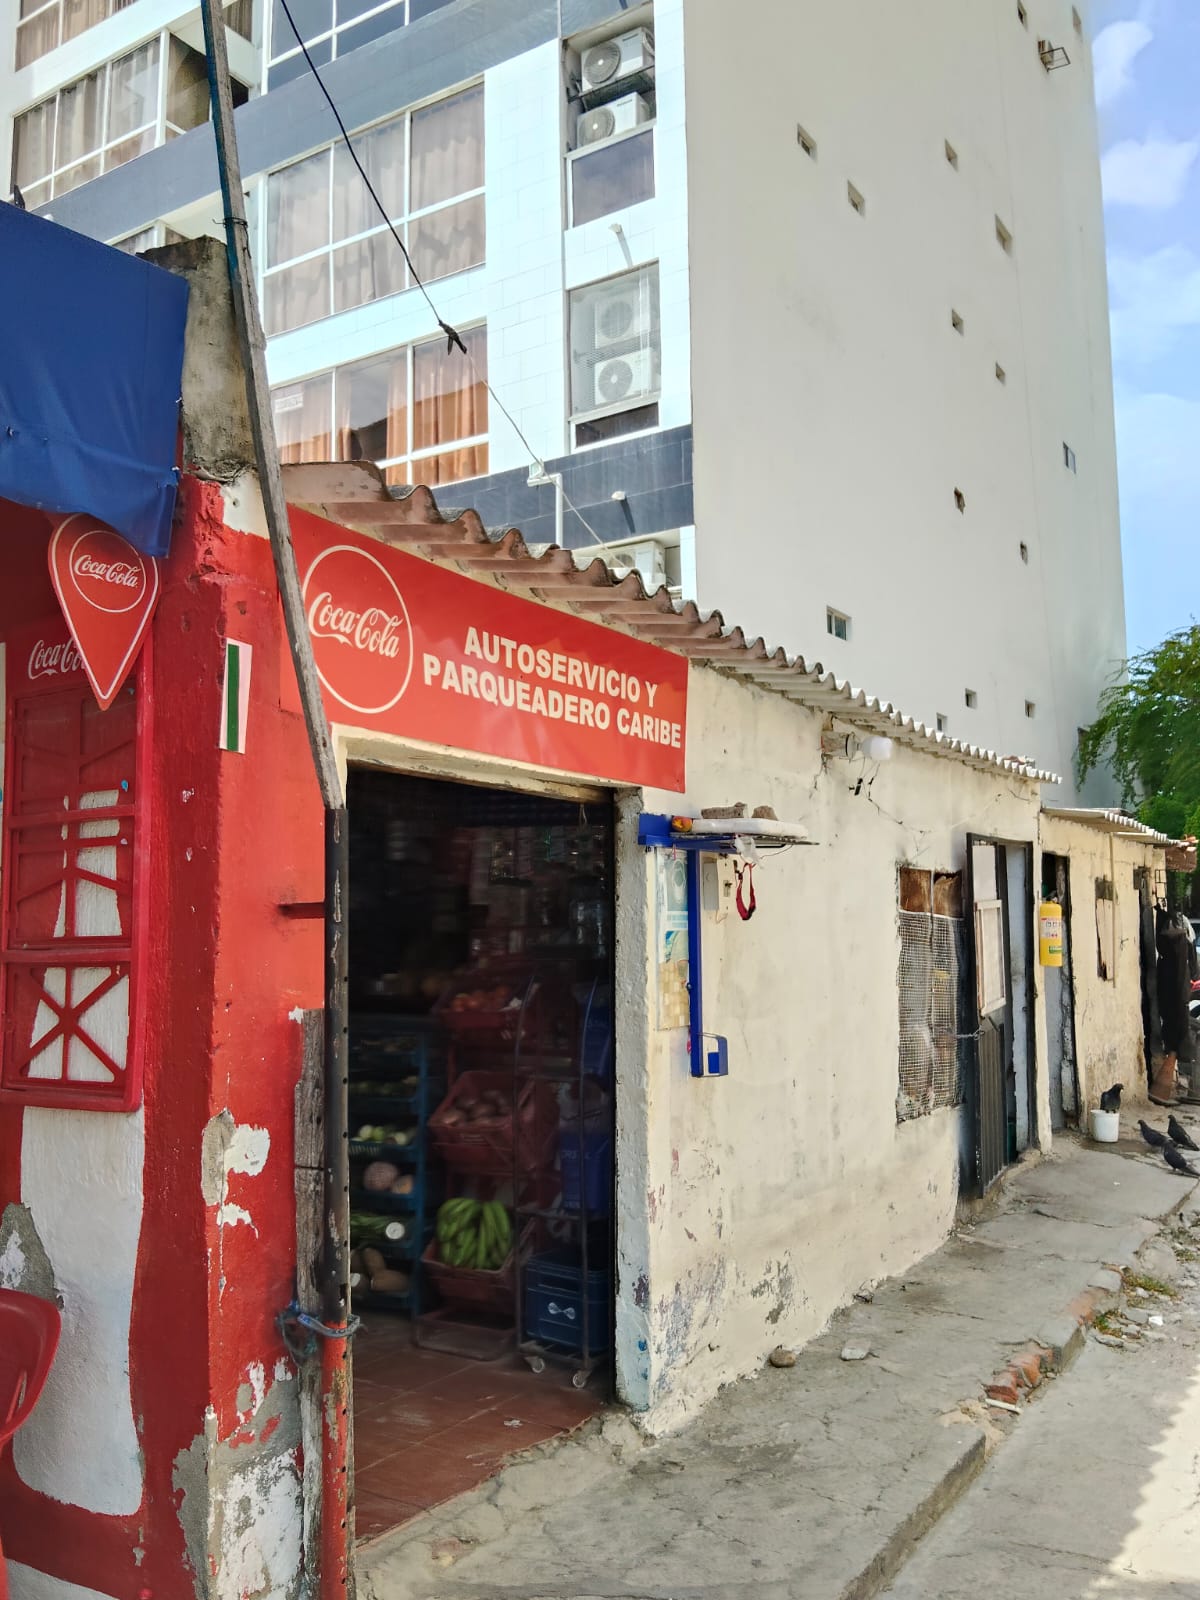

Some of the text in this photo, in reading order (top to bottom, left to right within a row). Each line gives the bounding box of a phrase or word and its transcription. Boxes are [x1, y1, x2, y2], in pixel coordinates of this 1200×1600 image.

[74, 554, 141, 588] Coca-Cola
[309, 591, 403, 659] Coca-Cola
[28, 639, 85, 680] Coca-Co
[464, 626, 658, 708] AUTOSERVICIO Y
[423, 653, 682, 748] PARQUEADERO CARIBE
